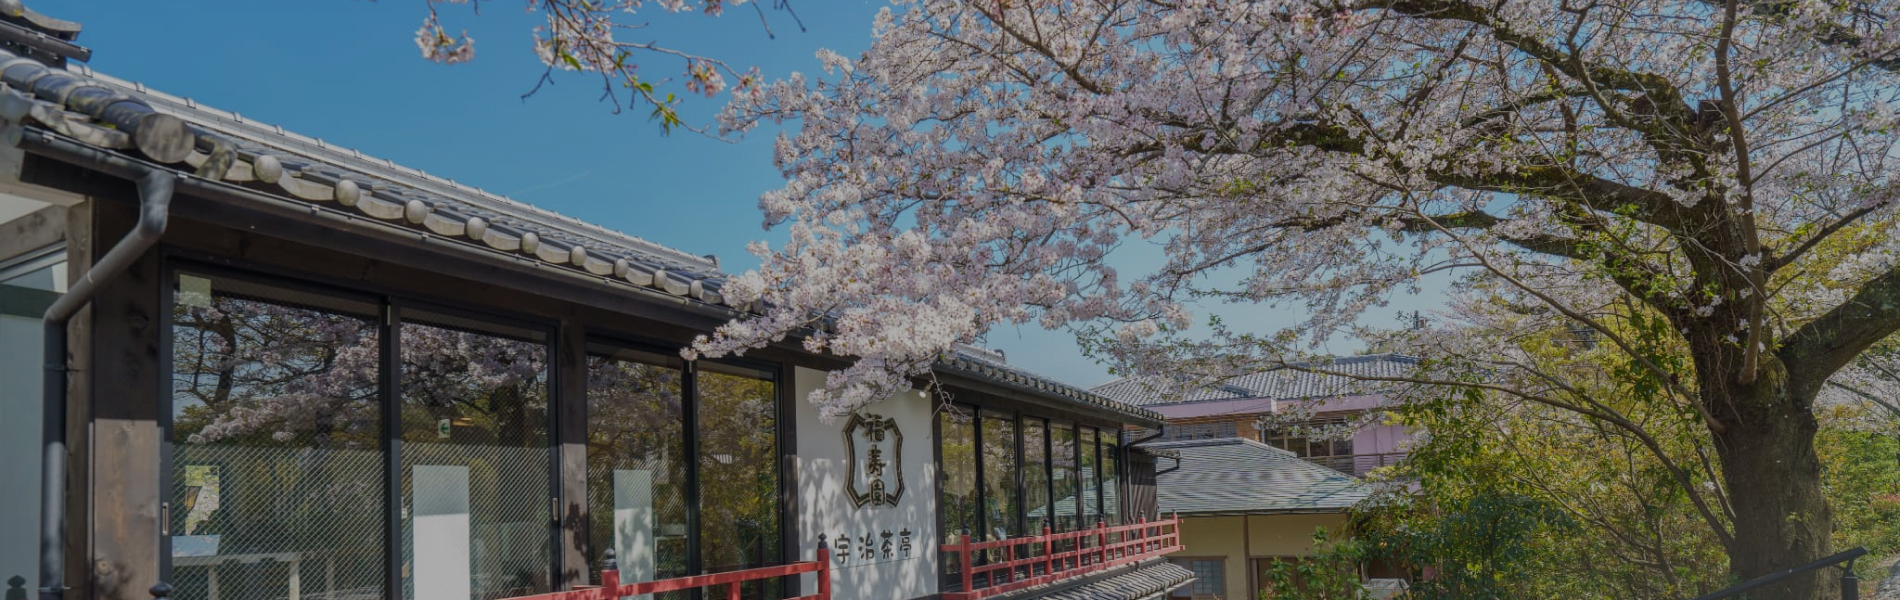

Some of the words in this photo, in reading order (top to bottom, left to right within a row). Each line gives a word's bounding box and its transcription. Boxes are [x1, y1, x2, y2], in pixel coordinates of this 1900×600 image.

[864, 413, 886, 507] 福寿園
[834, 527, 912, 564] 宇治茶亭
